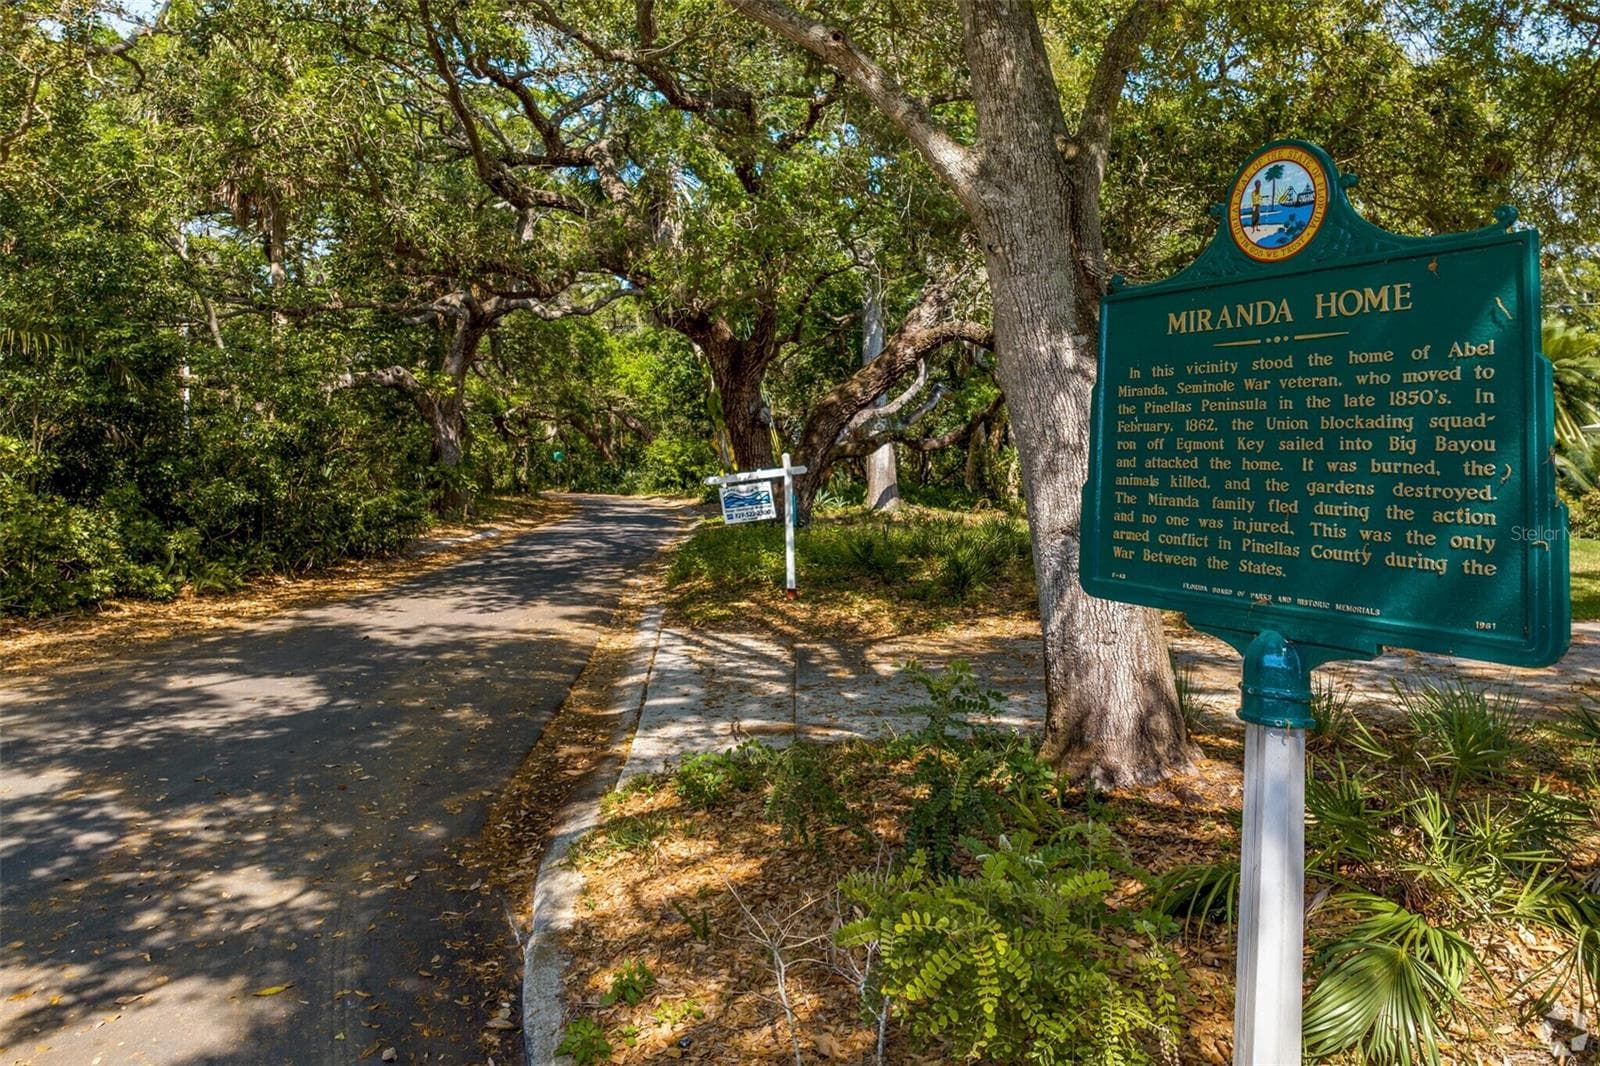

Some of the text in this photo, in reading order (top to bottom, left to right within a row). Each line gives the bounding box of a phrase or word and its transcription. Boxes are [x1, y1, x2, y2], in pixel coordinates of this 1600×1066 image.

[1168, 283, 1412, 334] MIRANDA HOME
[1130, 340, 1494, 379] In this vicinity stood the home of Abel
[1177, 380, 1234, 394] Seminole
[1244, 378, 1270, 390] War
[1356, 372, 1391, 385] who
[1403, 366, 1461, 383] moved
[1474, 364, 1495, 379] to
[1118, 388, 1495, 414] the Pinellas Peninsula in the late 1850's. In
[1232, 418, 1254, 430] the
[1266, 416, 1308, 430] Union
[1320, 414, 1413, 432] blockading
[1429, 413, 1495, 431] squad-
[1118, 436, 1496, 455] ron off Egmont Key sailed into Big Bayou
[1116, 456, 1496, 476] and attacked the home. It was burned, the
[1115, 474, 1159, 487] animals
[1224, 477, 1250, 491] and
[1265, 479, 1290, 492] the
[1306, 480, 1375, 497] gardens
[1392, 482, 1497, 503] destroyed.
[1115, 492, 1496, 525] The Miranda family fled during the action
[1114, 510, 1134, 522] and
[1142, 513, 1157, 524] no
[1166, 515, 1190, 527] one
[1199, 518, 1224, 529] was
[1310, 522, 1347, 538] This
[1359, 529, 1392, 542] was
[1406, 530, 1436, 546] the
[1450, 535, 1496, 554] only
[1113, 529, 1497, 576] armed conflict in Pinellas County during the
[1113, 546, 1286, 577] War Between the States.
[1182, 583, 1208, 592] FLORIDA
[1212, 587, 1233, 595] BOARD
[1278, 595, 1292, 603] AND
[1296, 598, 1330, 609] HISTORIC
[1335, 603, 1380, 616] MEMORIALS
